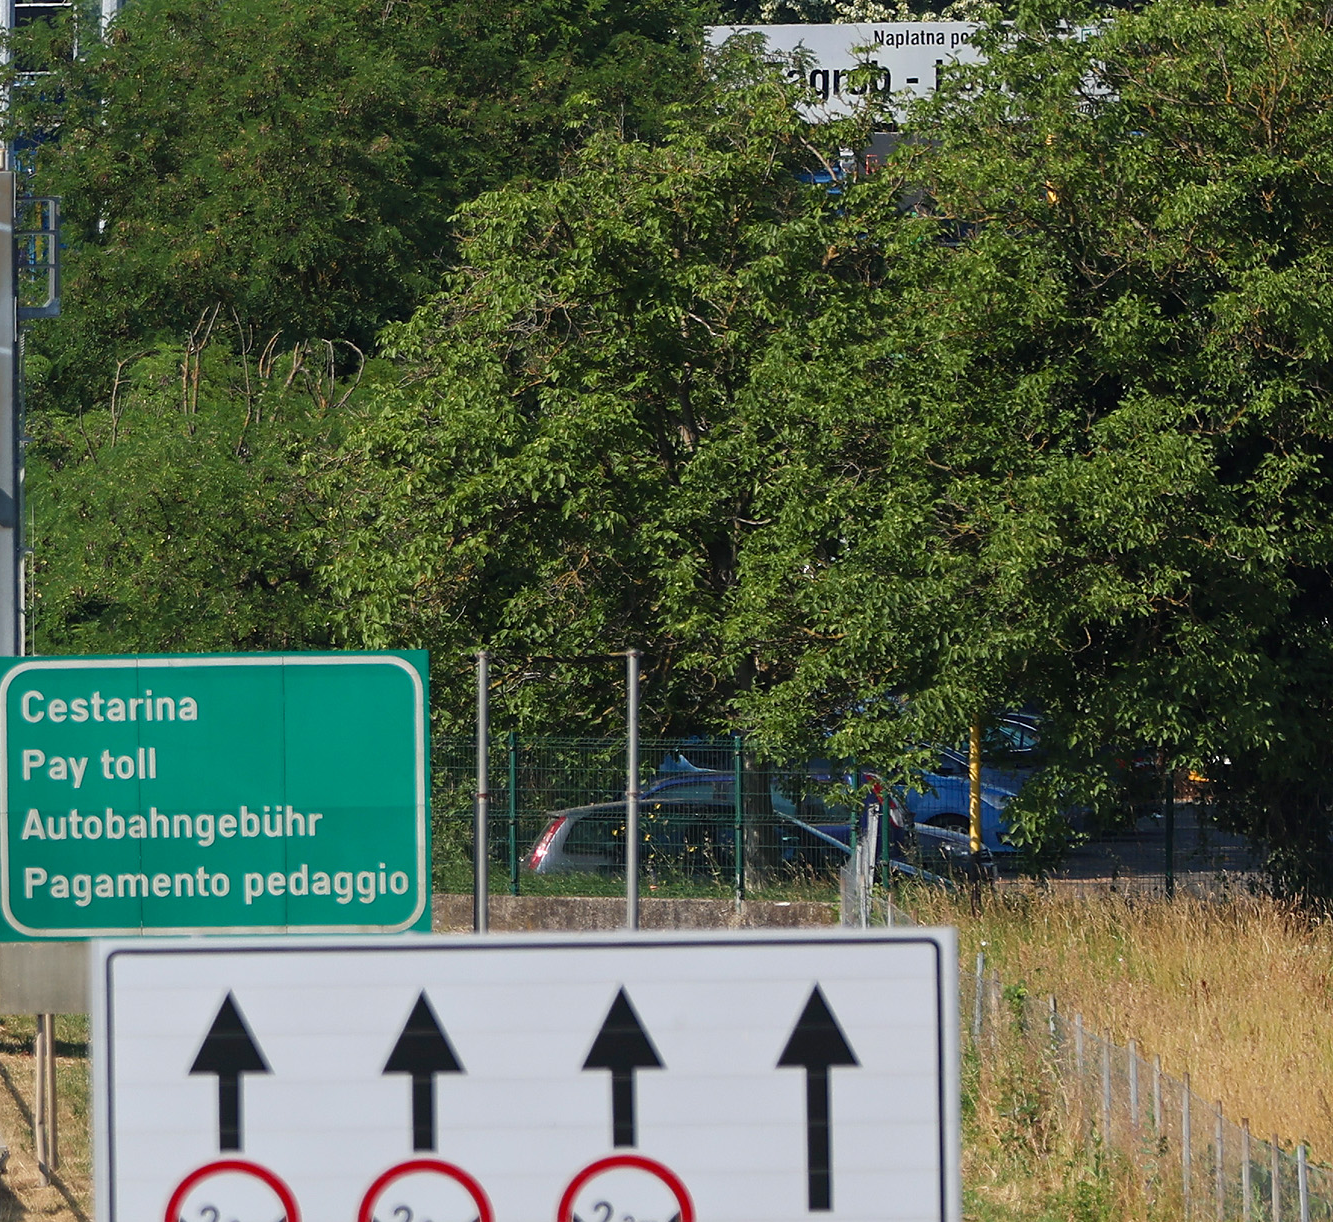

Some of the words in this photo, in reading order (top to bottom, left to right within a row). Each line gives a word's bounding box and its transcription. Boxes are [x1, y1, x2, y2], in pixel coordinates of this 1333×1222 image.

[873, 30, 946, 49] Naplatna
[21, 689, 199, 723] Cestarina
[22, 748, 89, 788] Pay
[101, 746, 157, 780] toll
[21, 805, 323, 847] Autobahngebühr
[24, 865, 230, 907] Pagamento
[244, 862, 410, 905] pedaggio
